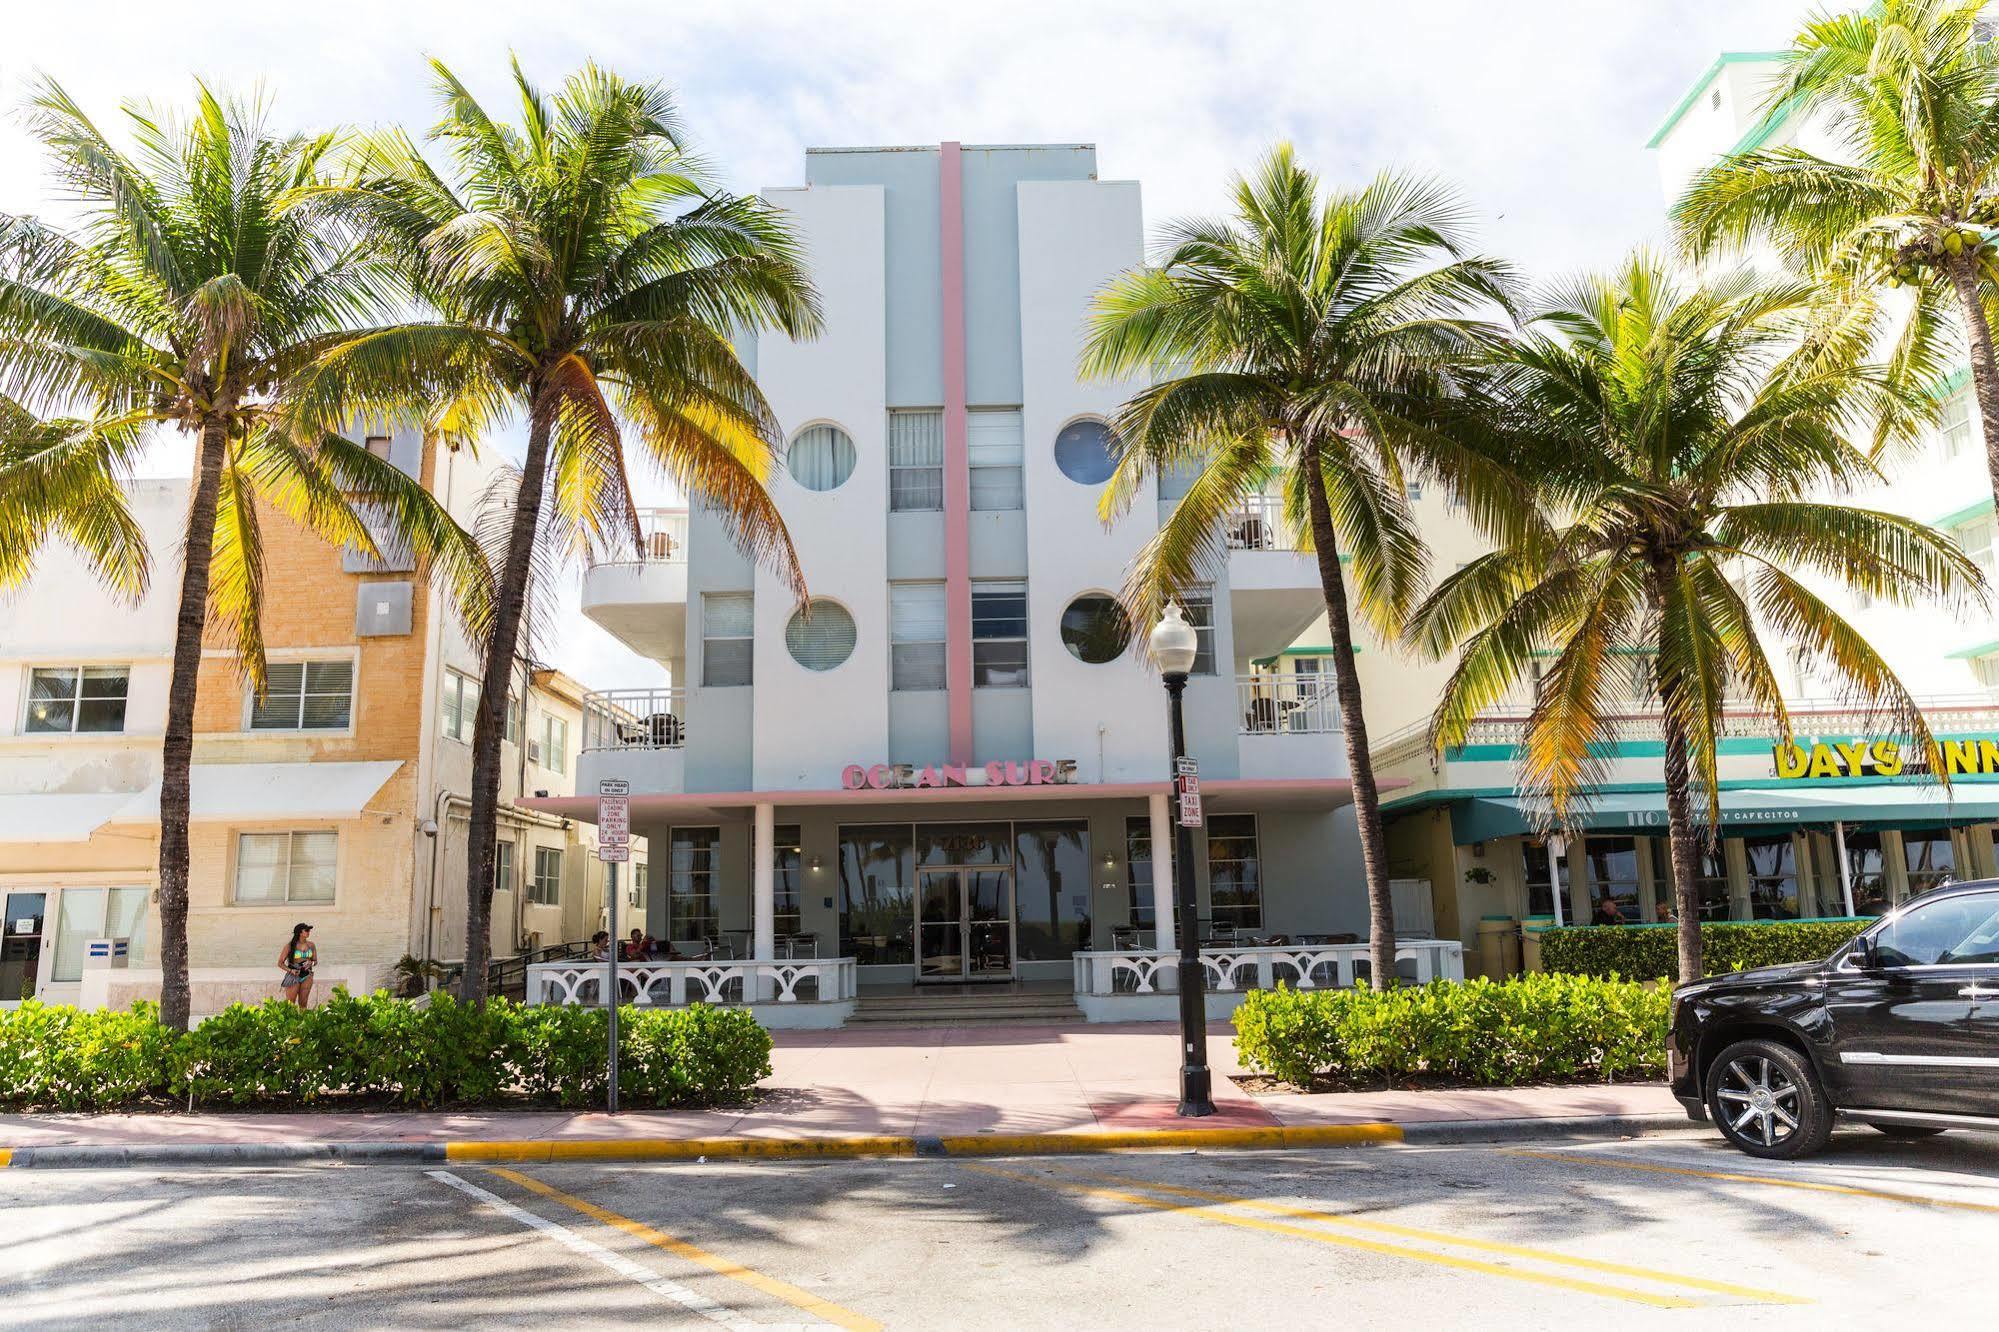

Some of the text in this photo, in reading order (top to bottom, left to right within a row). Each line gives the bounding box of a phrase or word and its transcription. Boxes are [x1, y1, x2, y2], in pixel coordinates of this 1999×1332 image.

[1775, 741, 1903, 779] DAYS
[841, 759, 1078, 790] OCEAN SURF
[1184, 795, 1198, 806] TAXI
[1184, 807, 1199, 817] ZONE
[1734, 811, 1799, 820] CAFECITOS
